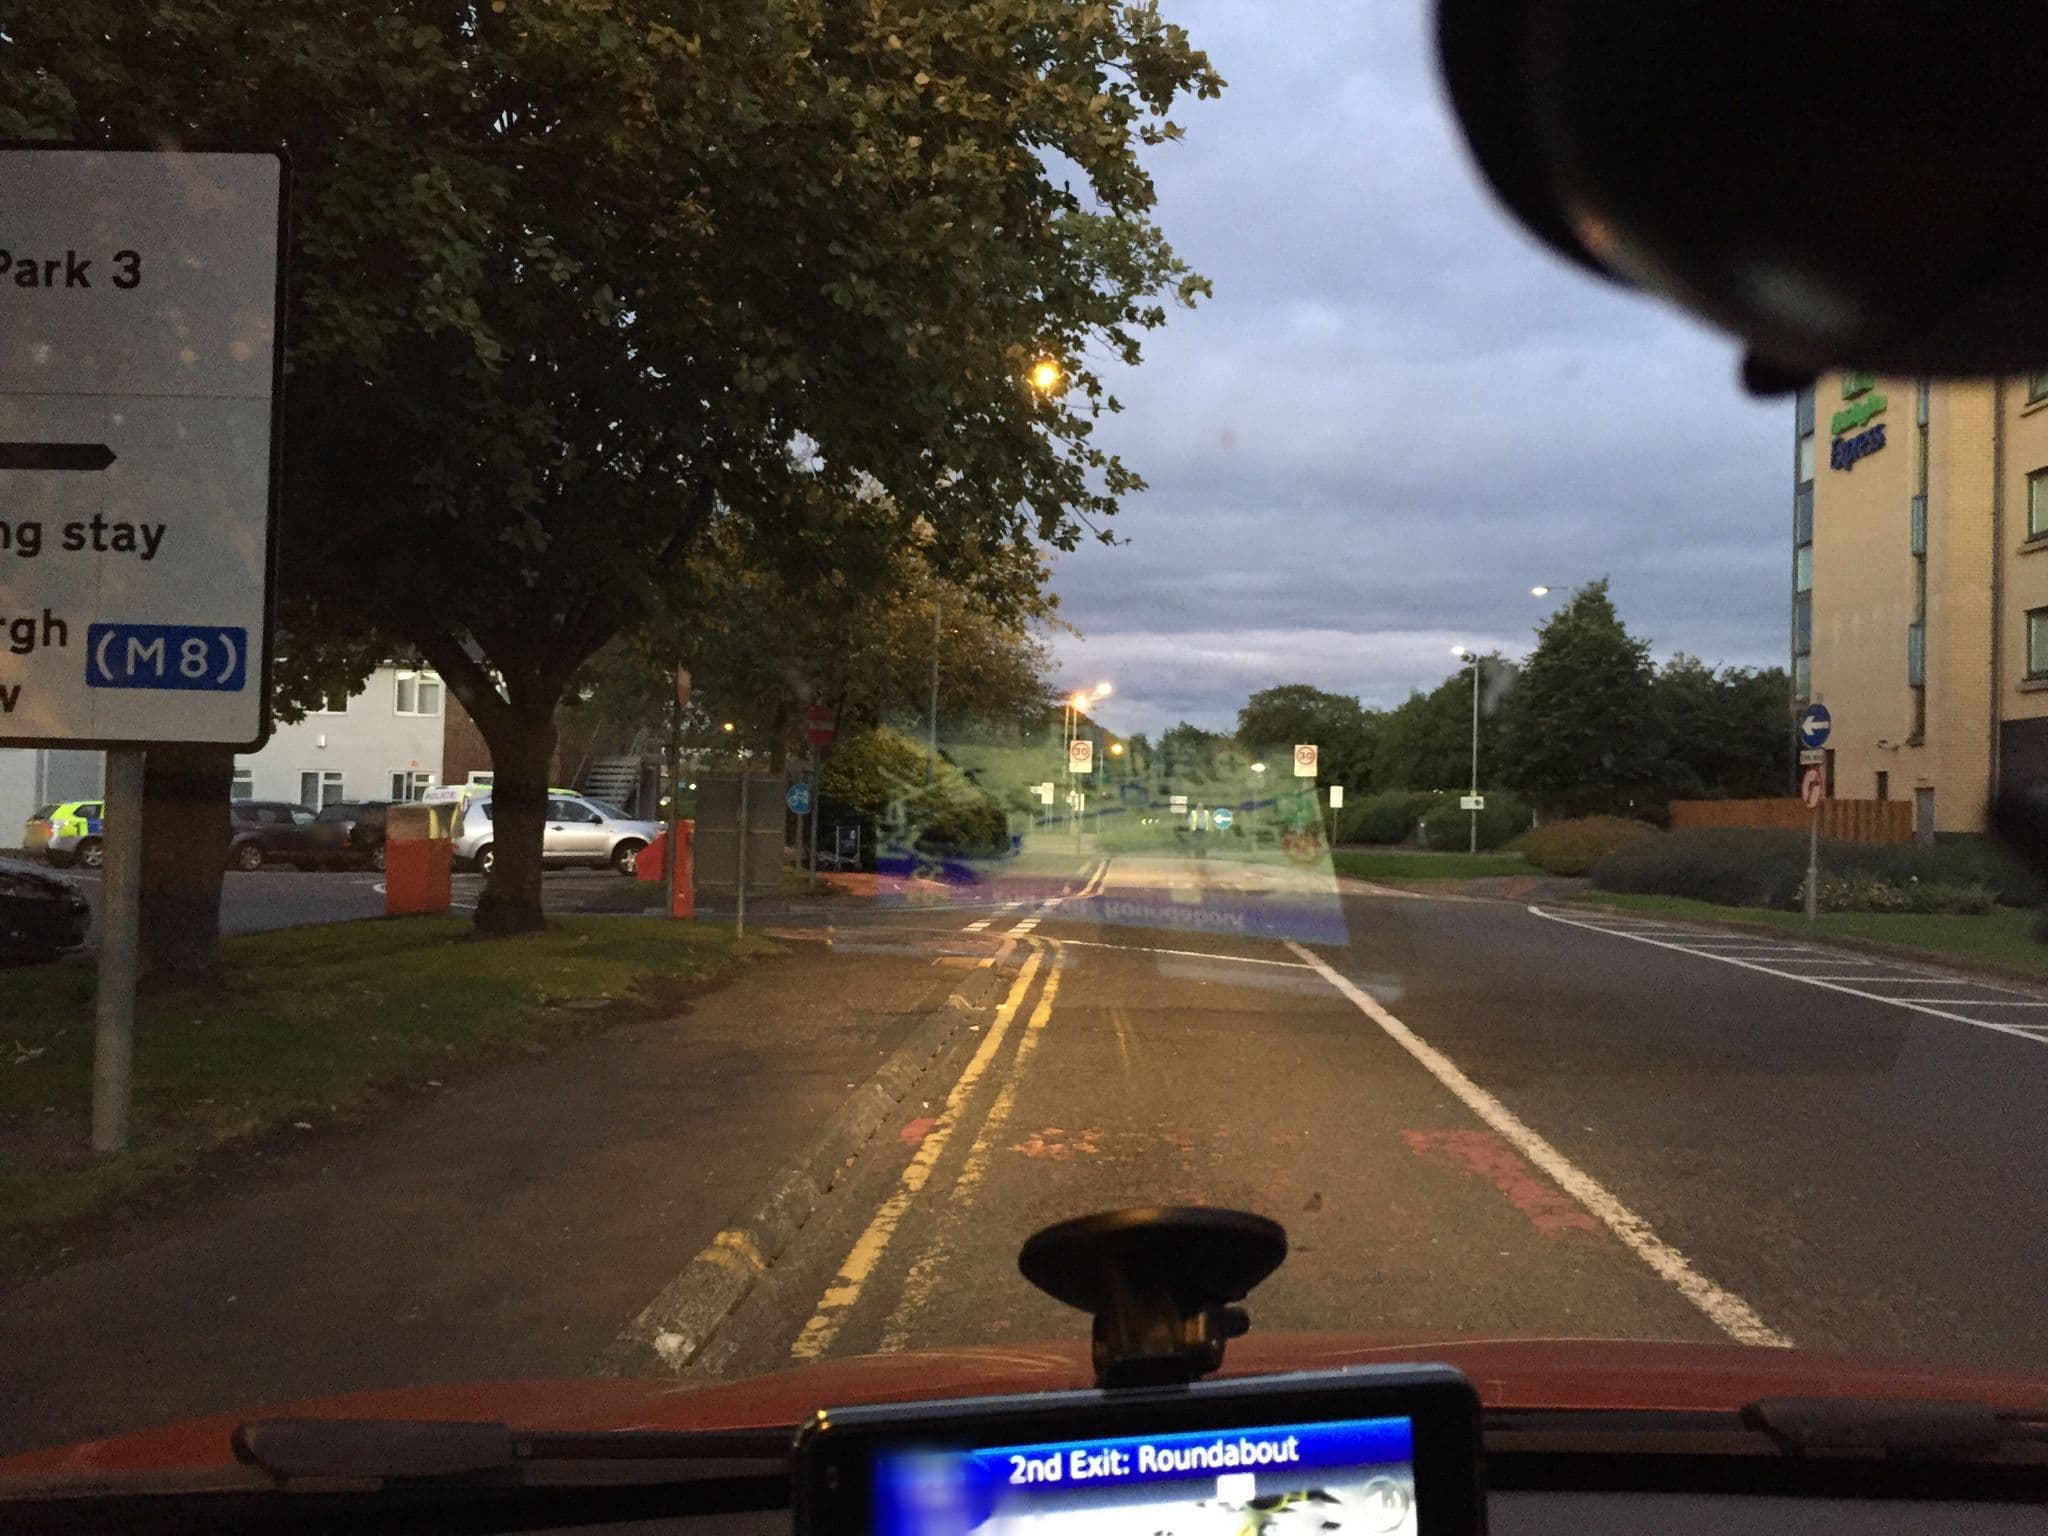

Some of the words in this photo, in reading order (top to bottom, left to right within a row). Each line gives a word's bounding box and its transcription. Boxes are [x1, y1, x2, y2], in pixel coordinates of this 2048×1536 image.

[111, 250, 142, 289] 3
[61, 512, 166, 561] stay
[0, 607, 68, 655] gh
[1009, 1452, 1063, 1484] 2nd
[1070, 1448, 1130, 1479] Exit:
[1138, 1435, 1300, 1473] Roundabout
